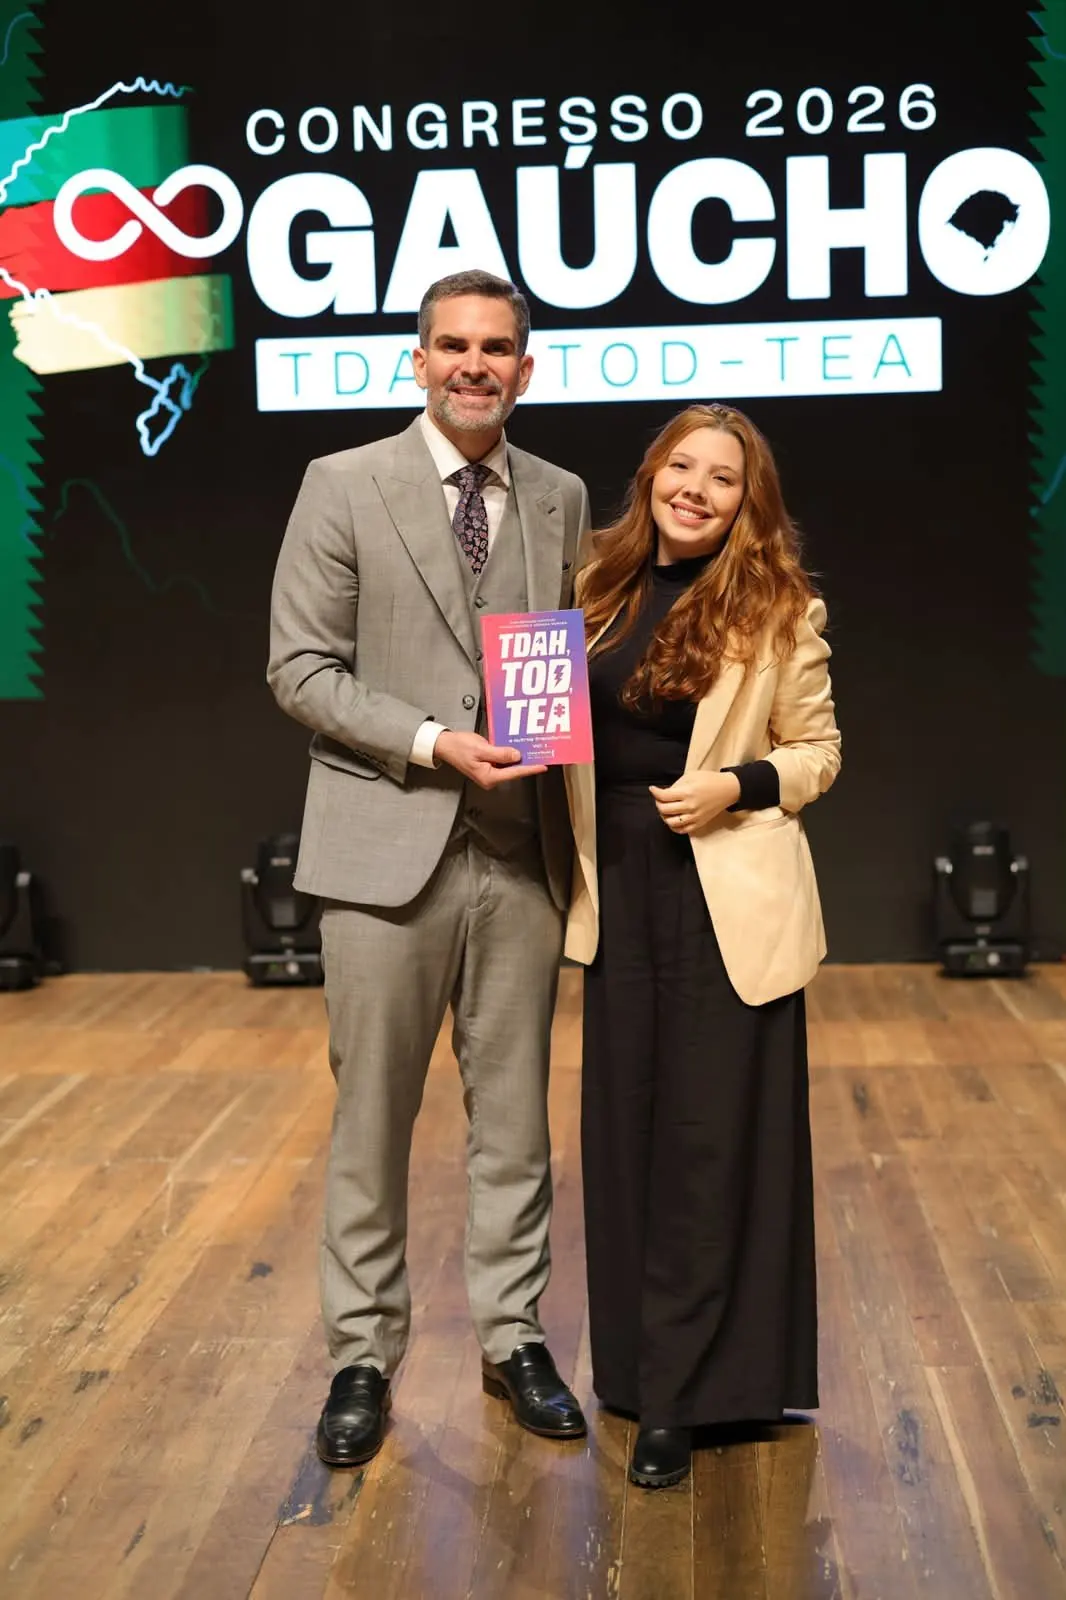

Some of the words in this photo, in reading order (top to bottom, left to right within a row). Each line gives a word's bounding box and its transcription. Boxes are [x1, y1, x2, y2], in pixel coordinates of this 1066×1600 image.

[246, 92, 703, 156] CONGRESSO
[745, 83, 937, 137] 2026
[246, 145, 1051, 319] GAÚCHO
[279, 349, 416, 396] TDA
[498, 629, 570, 659] TDAH,
[501, 658, 573, 697] TOD,
[506, 697, 571, 736] TEA
